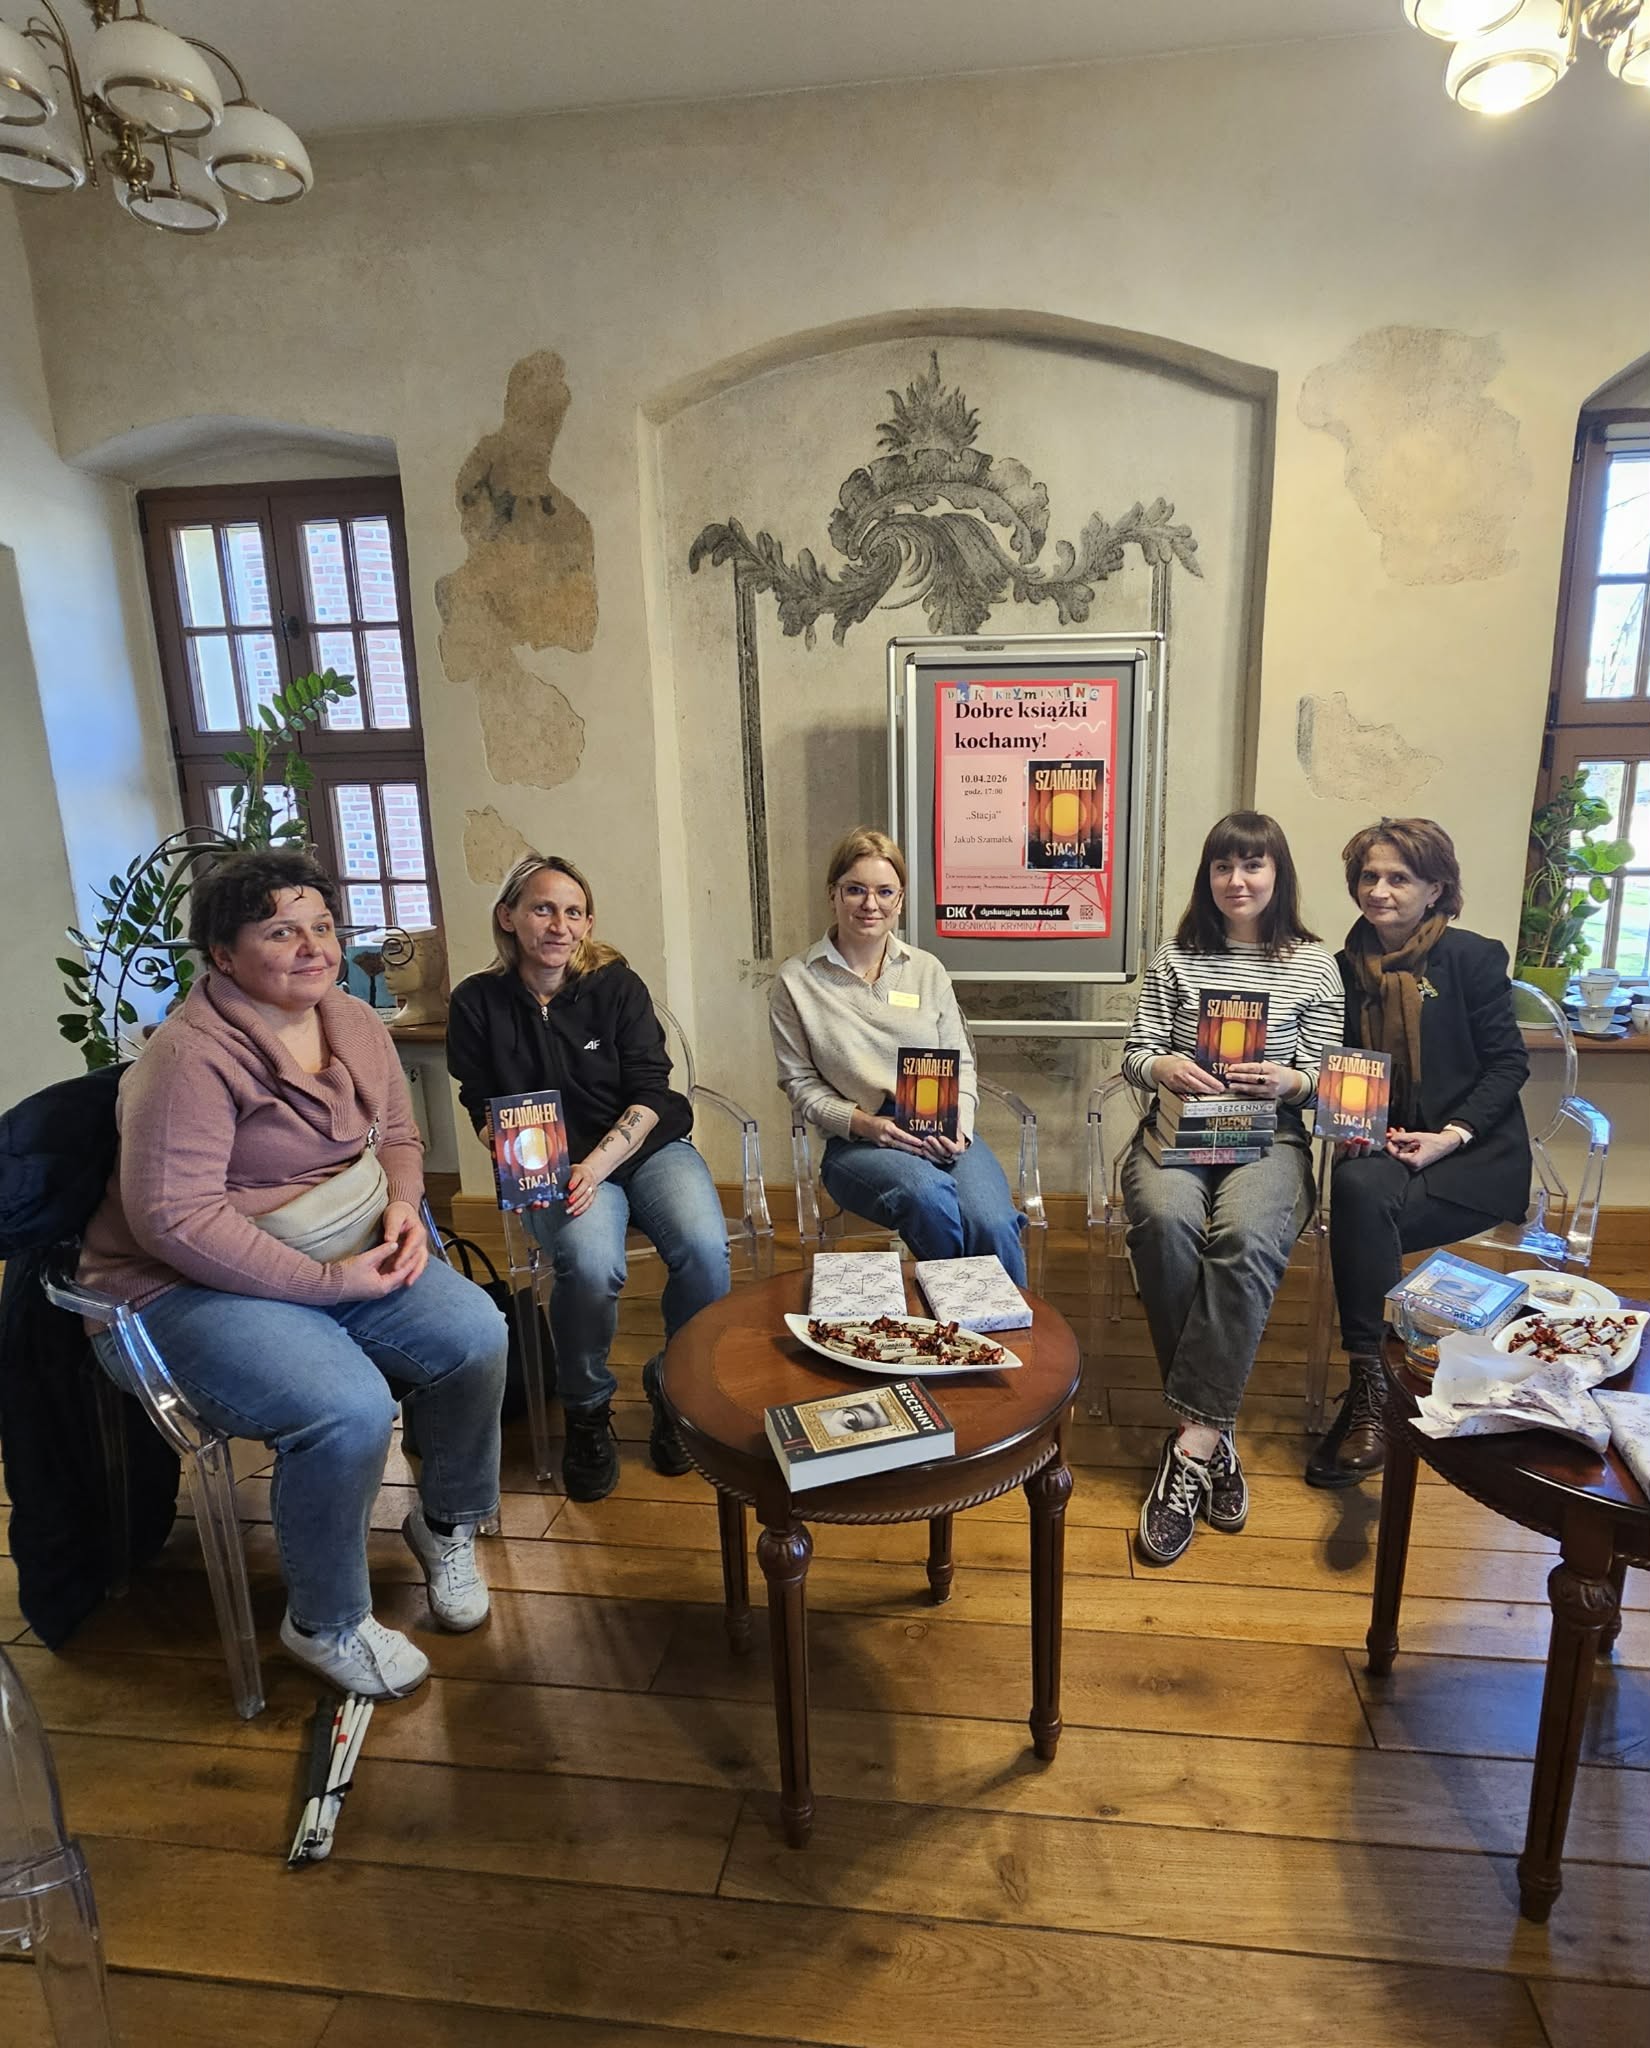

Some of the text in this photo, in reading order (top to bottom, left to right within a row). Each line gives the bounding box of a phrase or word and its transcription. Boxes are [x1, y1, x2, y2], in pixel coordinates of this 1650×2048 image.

[955, 700, 1088, 722] Dobre książki
[955, 732, 1047, 752] kochamy!
[961, 774, 1008, 783] 10.04.2026
[1035, 769, 1097, 790] SZAMAŁEK
[964, 788, 983, 796] godz.
[953, 835, 976, 844] Jakub
[1045, 842, 1086, 856] STACJA
[980, 907, 1063, 917] dyskusyjny klub książki
[1207, 999, 1264, 1020] SZAMAŁEK
[903, 1057, 954, 1077] SZAMAŁEK
[1328, 1054, 1385, 1079] SZAMAŁEK
[499, 1102, 558, 1129] SZAMAŁEK
[1217, 1102, 1265, 1113] BEZCENNY
[909, 1119, 944, 1133] STACJA
[1333, 1112, 1372, 1130] STACJA
[518, 1172, 558, 1191] STACJA
[895, 1382, 937, 1430] BEZCENNY
